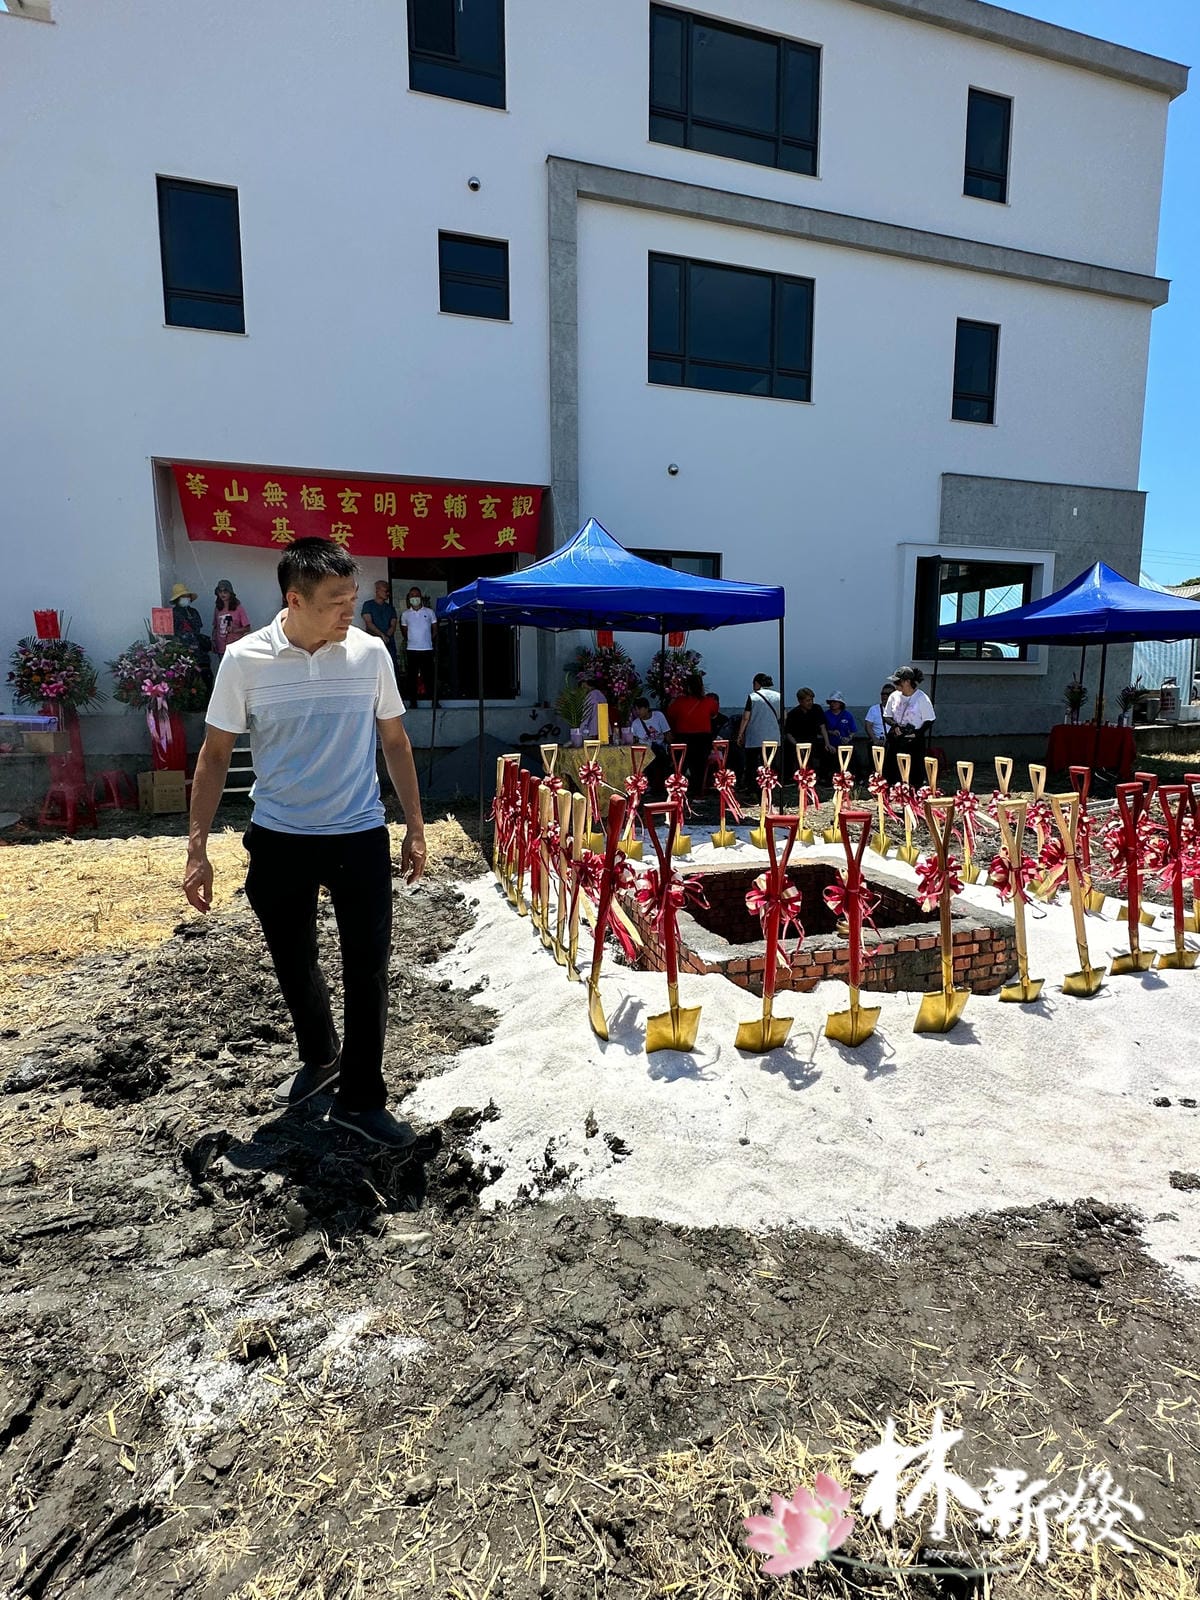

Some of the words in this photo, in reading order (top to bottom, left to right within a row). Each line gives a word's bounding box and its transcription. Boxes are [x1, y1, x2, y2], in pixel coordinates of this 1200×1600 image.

[211, 509, 518, 552] 奠基安寶大典
